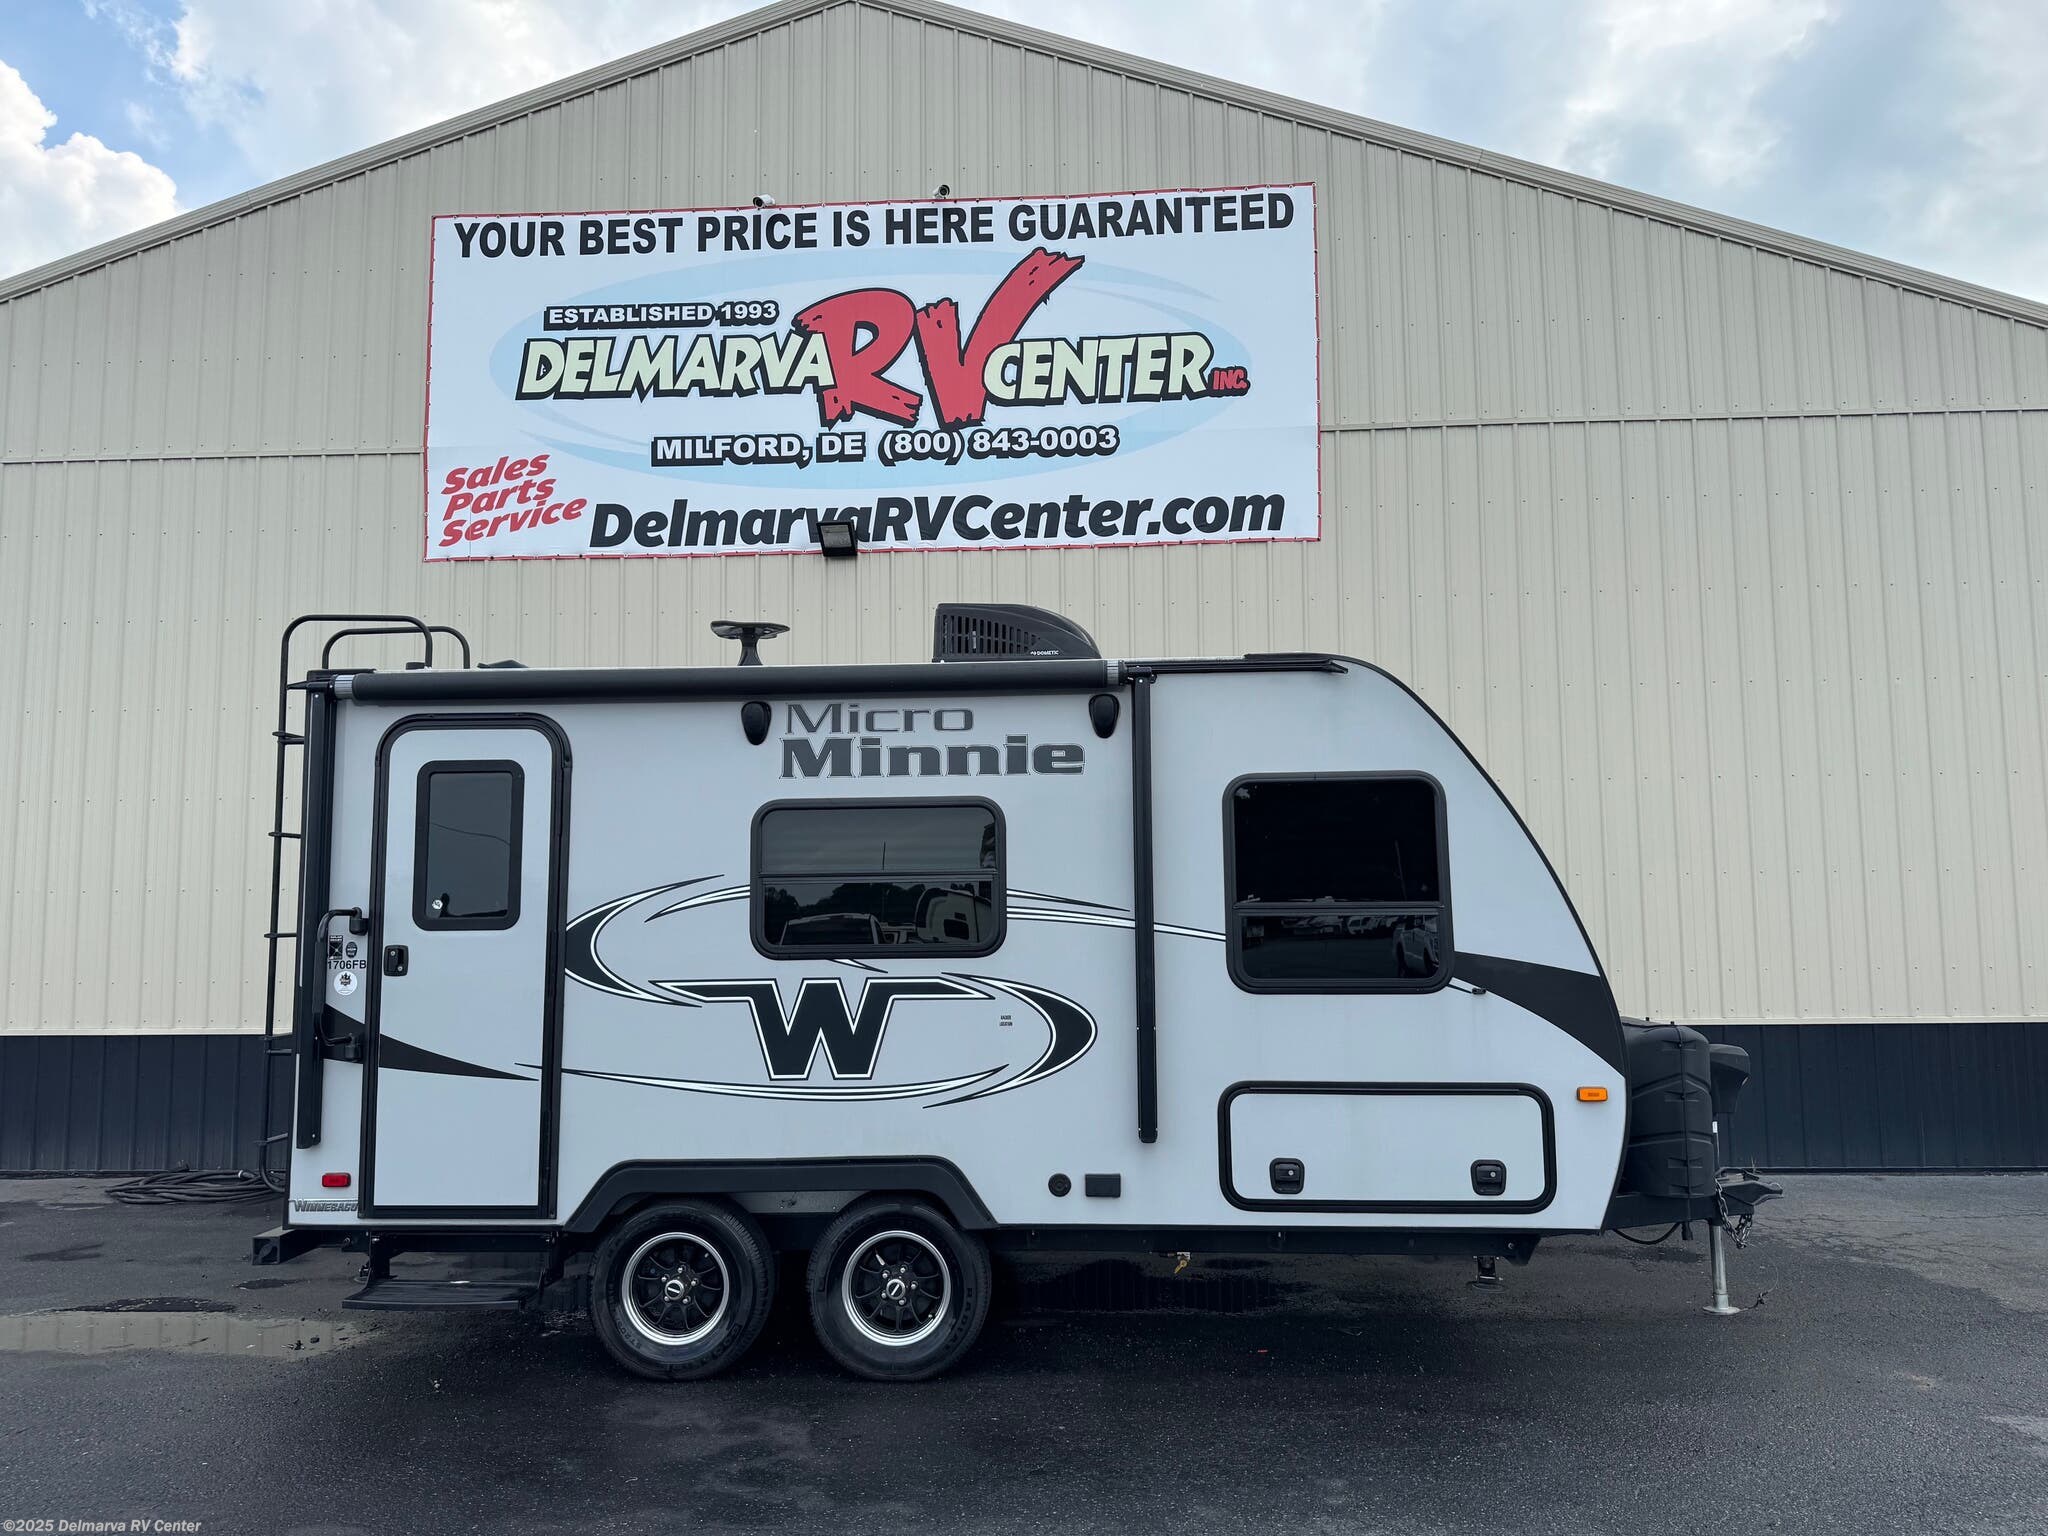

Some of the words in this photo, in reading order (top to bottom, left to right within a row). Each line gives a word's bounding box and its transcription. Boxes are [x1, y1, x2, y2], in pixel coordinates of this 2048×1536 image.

[454, 220, 565, 258] YOUR
[579, 217, 683, 256] BEST
[698, 212, 818, 252] PRICE
[833, 209, 870, 247] IS
[885, 206, 994, 244] HERE
[1008, 193, 1294, 241] GUARANTEED
[548, 304, 713, 324] ESTABLISHED
[720, 301, 777, 321] 1993
[516, 331, 836, 398] DELMARVA
[792, 246, 1085, 430] RV
[982, 332, 1214, 401] CENTER
[1211, 367, 1249, 391] INC.
[654, 434, 811, 463] MILFORD,
[820, 433, 865, 457] DE
[882, 431, 964, 462] (800)
[972, 427, 1118, 454] 843-0003
[441, 454, 550, 495] Sales
[443, 477, 557, 521] Parts
[589, 492, 1285, 548] DelmarvaRVCenter.com
[438, 498, 588, 547] Service
[785, 702, 974, 735] Micro
[779, 734, 1086, 780] Minnie
[327, 960, 367, 970] 1706FB
